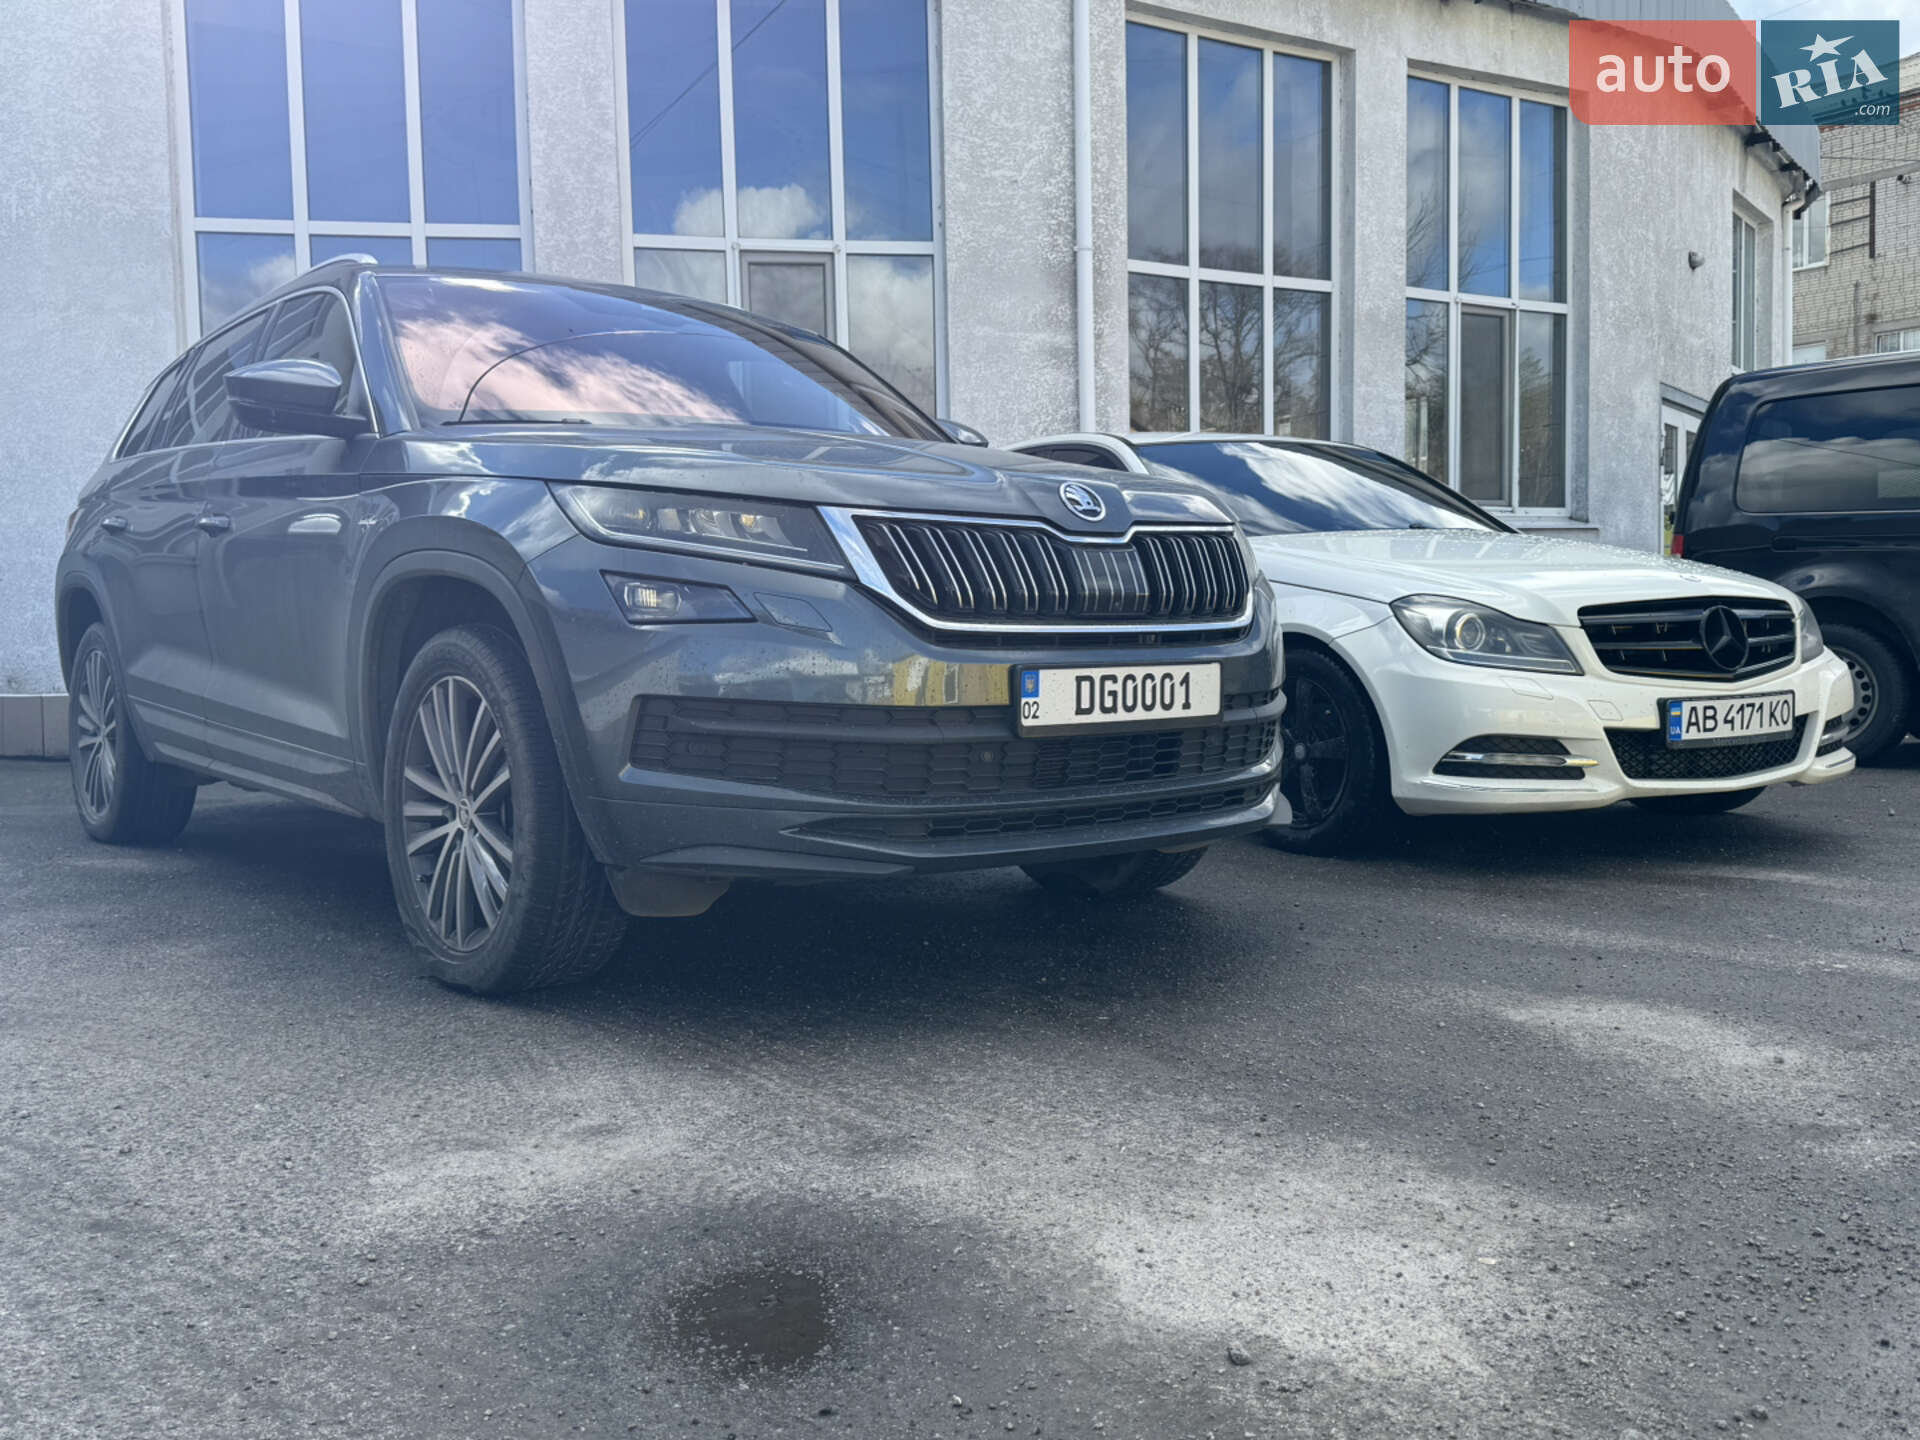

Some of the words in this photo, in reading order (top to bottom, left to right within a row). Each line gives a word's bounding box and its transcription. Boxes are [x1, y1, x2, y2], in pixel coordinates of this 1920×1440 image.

[1075, 672, 1191, 715] DG0001
[1022, 701, 1040, 719] 02
[1685, 705, 1718, 734] AB
[1723, 702, 1764, 731] 4171
[1768, 699, 1791, 727] KO
[1670, 725, 1681, 735] UA
